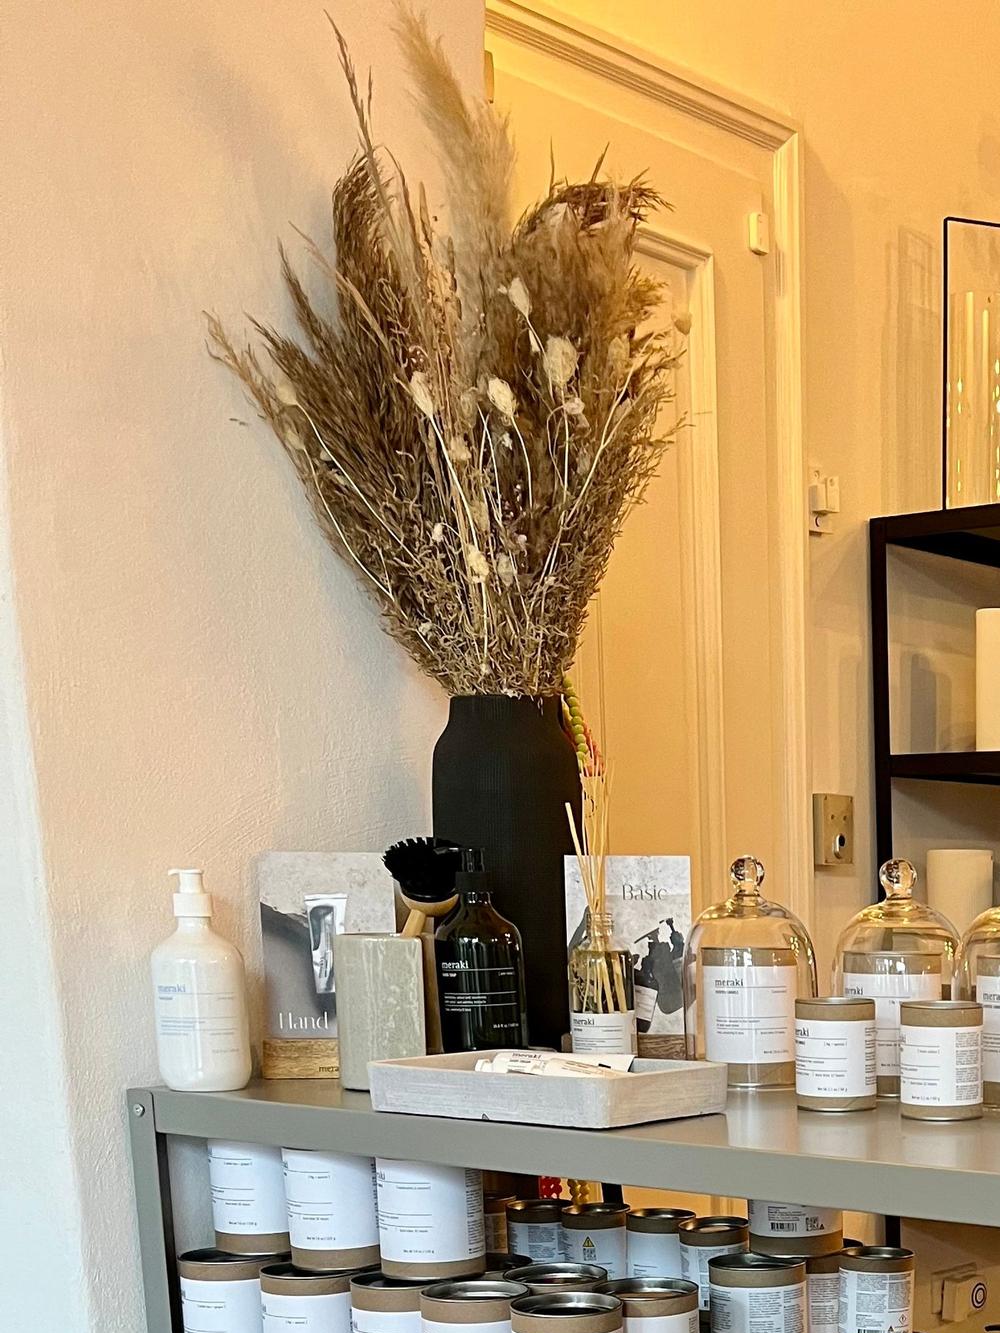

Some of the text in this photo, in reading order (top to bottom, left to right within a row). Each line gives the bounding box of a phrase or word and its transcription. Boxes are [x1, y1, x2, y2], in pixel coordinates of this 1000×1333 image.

[622, 884, 668, 901] Basic
[441, 960, 469, 969] meraki
[715, 979, 744, 987] meraki
[279, 1011, 329, 1030] Hand
[319, 1065, 339, 1073] mera
